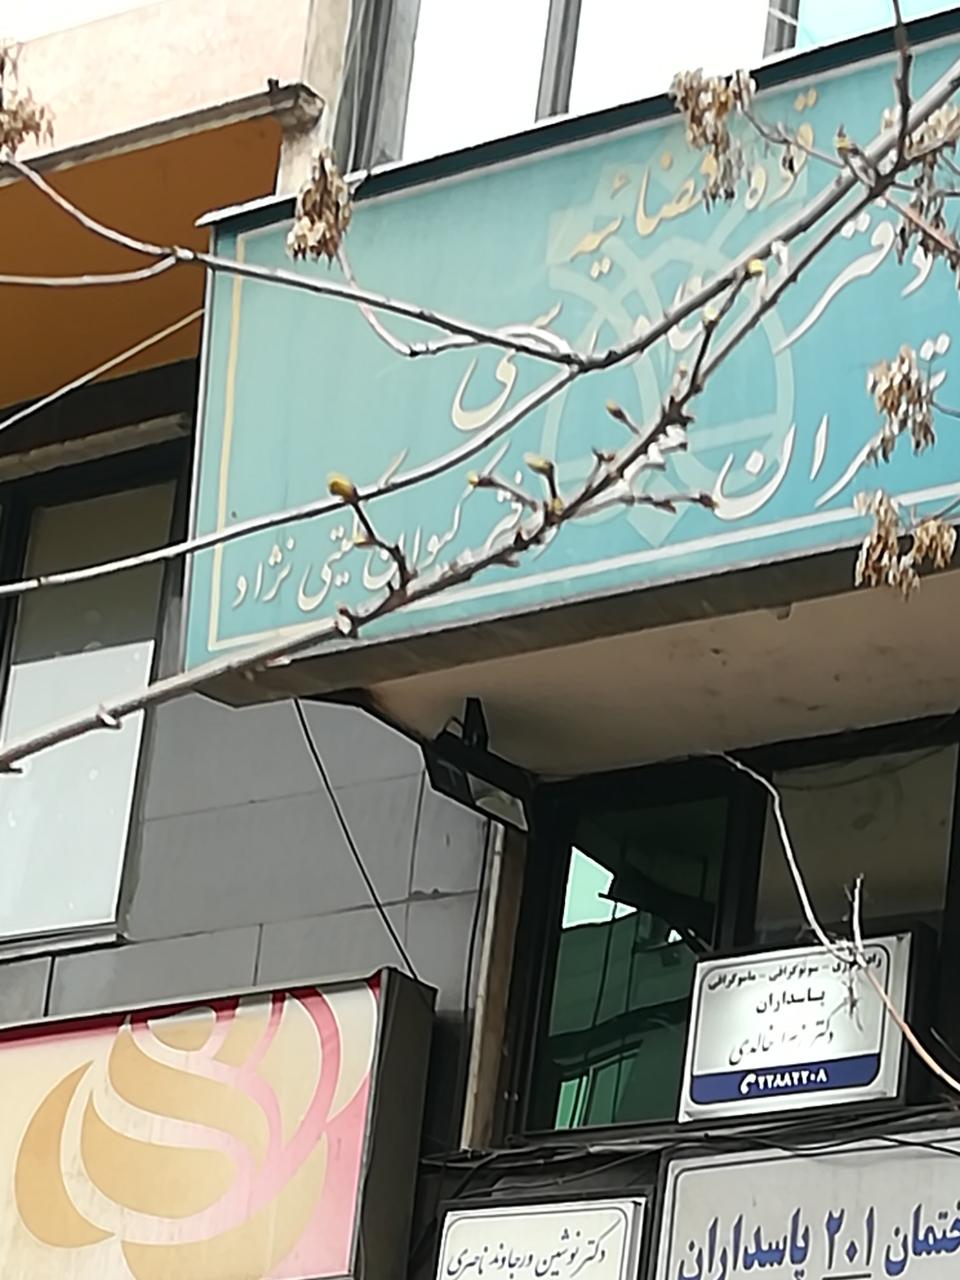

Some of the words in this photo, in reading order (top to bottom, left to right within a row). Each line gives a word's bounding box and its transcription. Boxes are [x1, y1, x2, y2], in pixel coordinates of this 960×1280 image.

[534, 1227, 581, 1277] نوشین
[570, 1217, 622, 1278] دکتر
[824, 1205, 875, 1270] ۲۰۱
